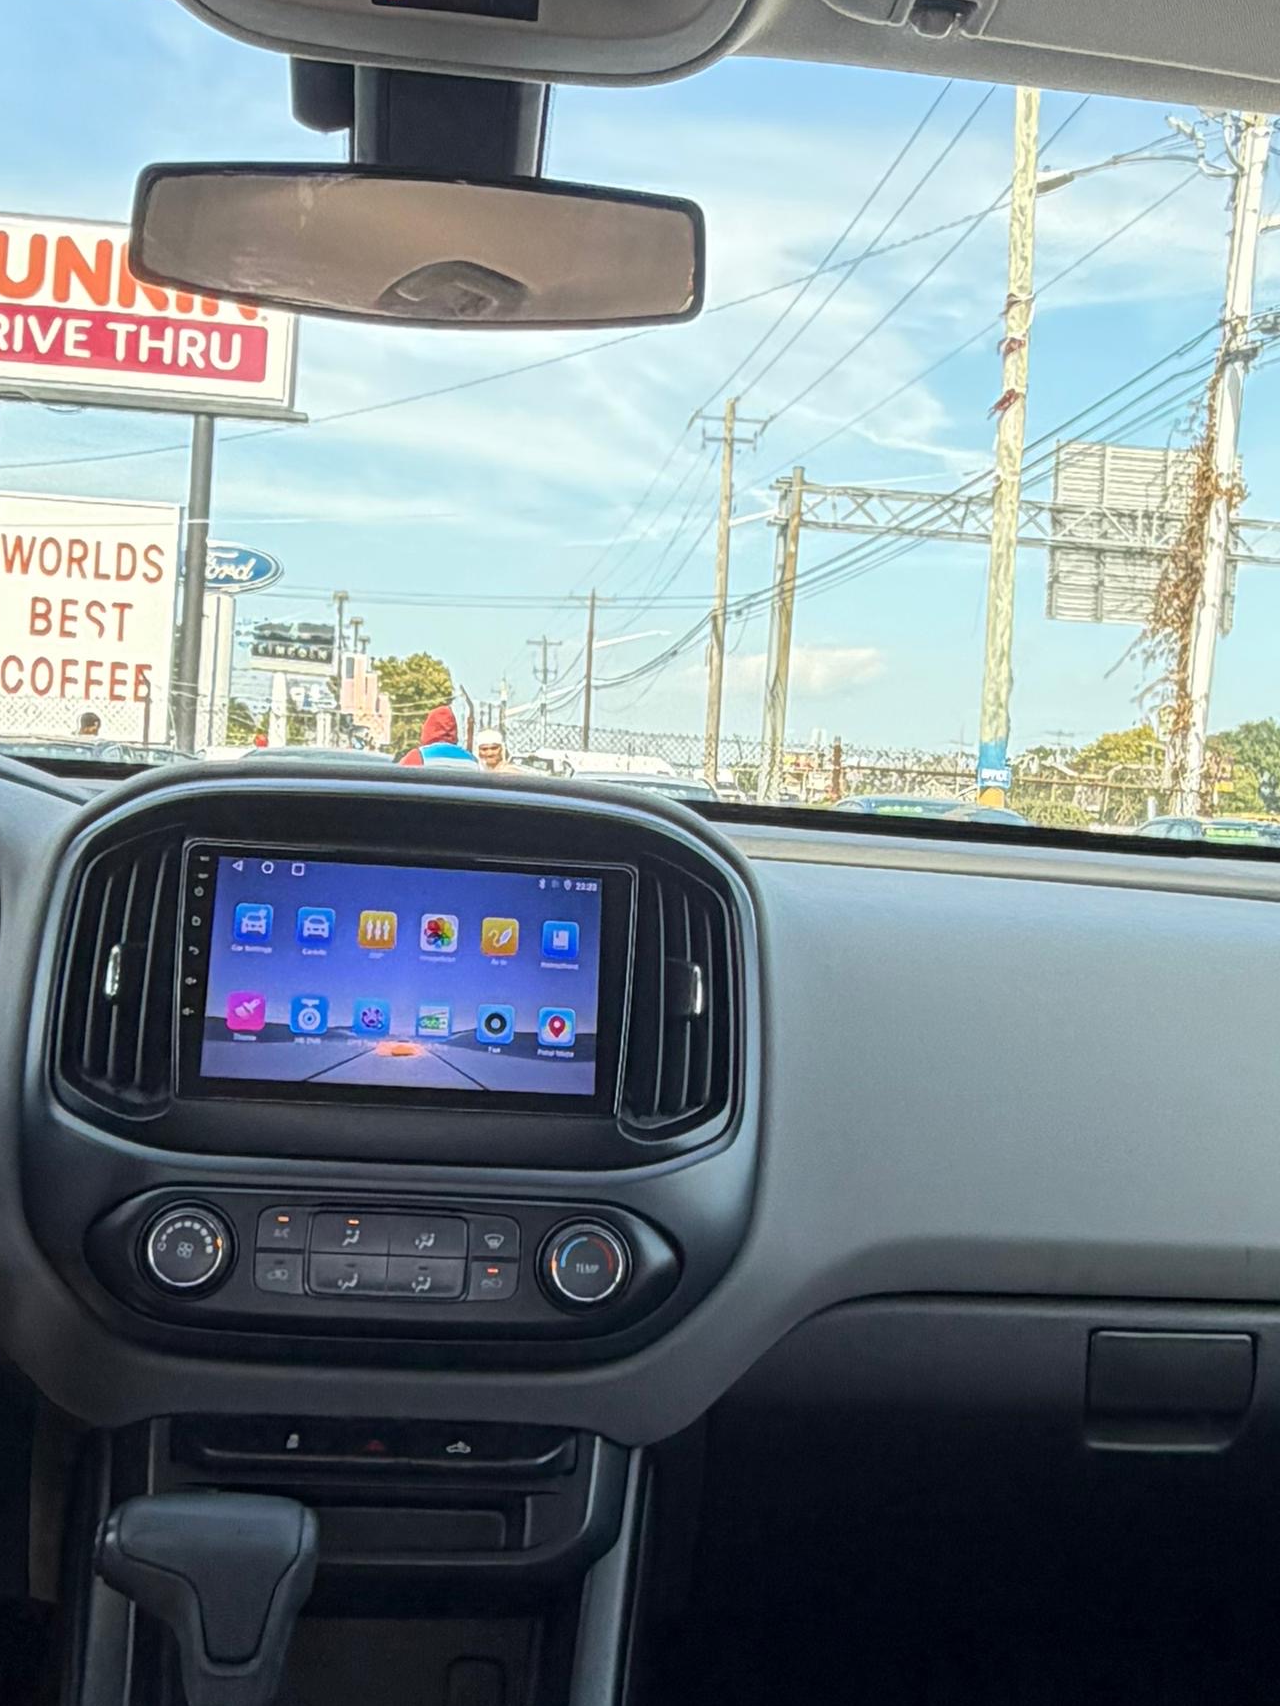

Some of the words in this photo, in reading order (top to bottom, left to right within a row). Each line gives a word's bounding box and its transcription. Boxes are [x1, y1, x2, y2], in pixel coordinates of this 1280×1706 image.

[105, 320, 242, 372] THRU
[0, 532, 165, 584] WORLDS
[29, 595, 134, 643] BEST
[0, 654, 153, 704] COFFEE
[575, 1262, 600, 1274] TEMP
